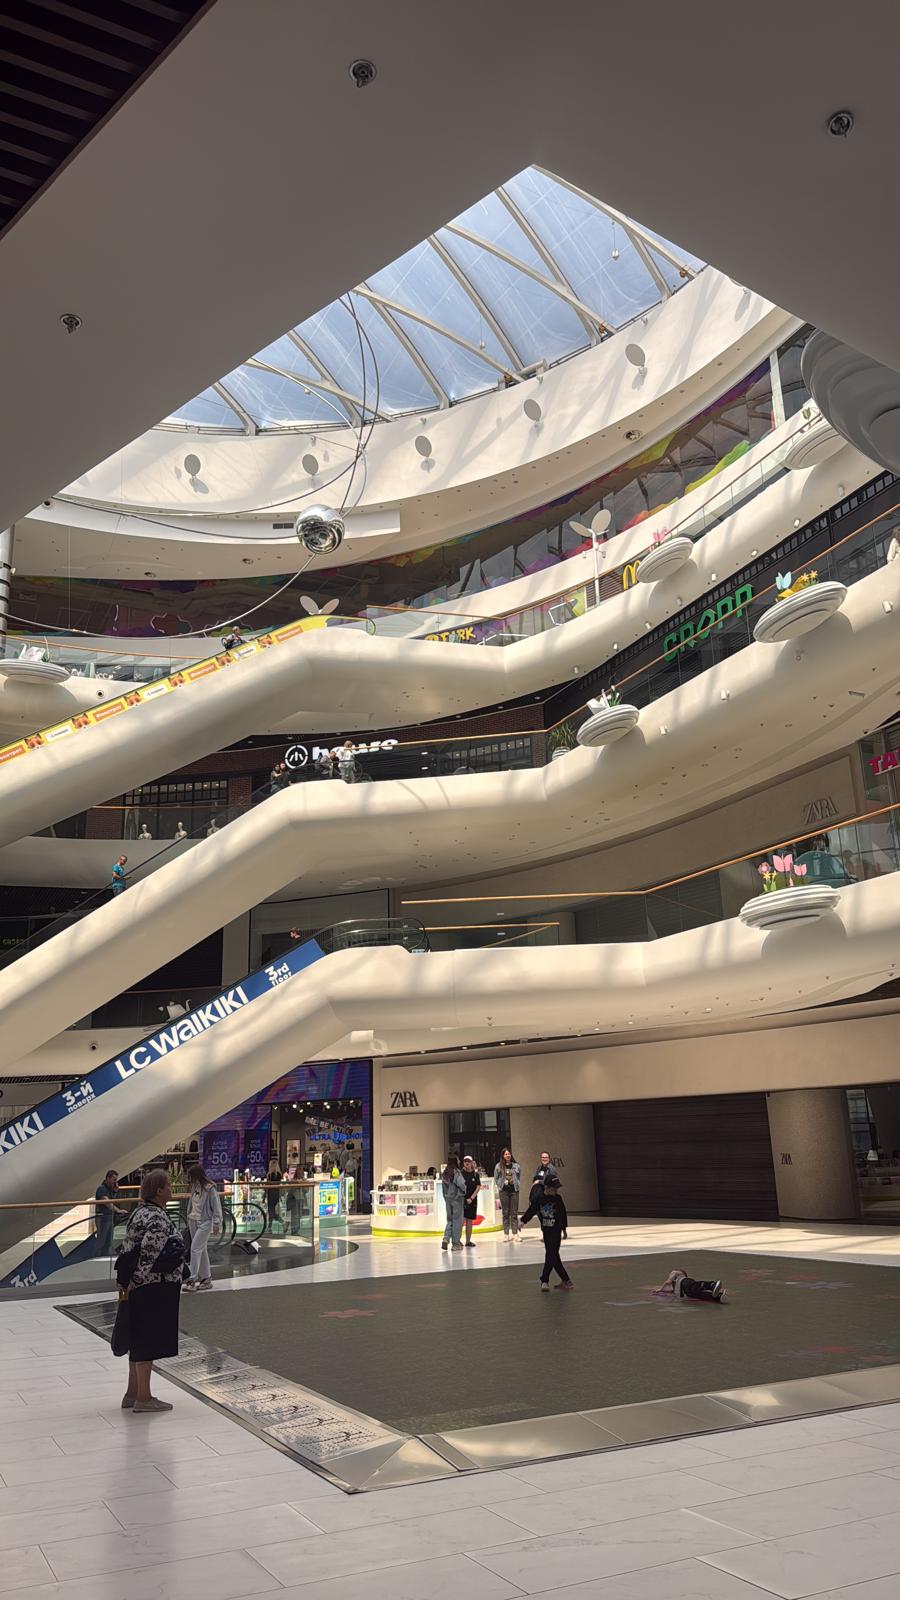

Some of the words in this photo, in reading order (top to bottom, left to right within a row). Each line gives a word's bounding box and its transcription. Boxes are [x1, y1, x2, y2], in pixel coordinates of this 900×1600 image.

[663, 584, 754, 662] CROPP
[802, 796, 839, 825] ZARA
[265, 962, 290, 981] 3rd
[114, 1046, 152, 1080] LC
[62, 1080, 94, 1107] 3-й
[68, 1093, 97, 1113] поверх
[390, 1090, 420, 1109] ZARA
